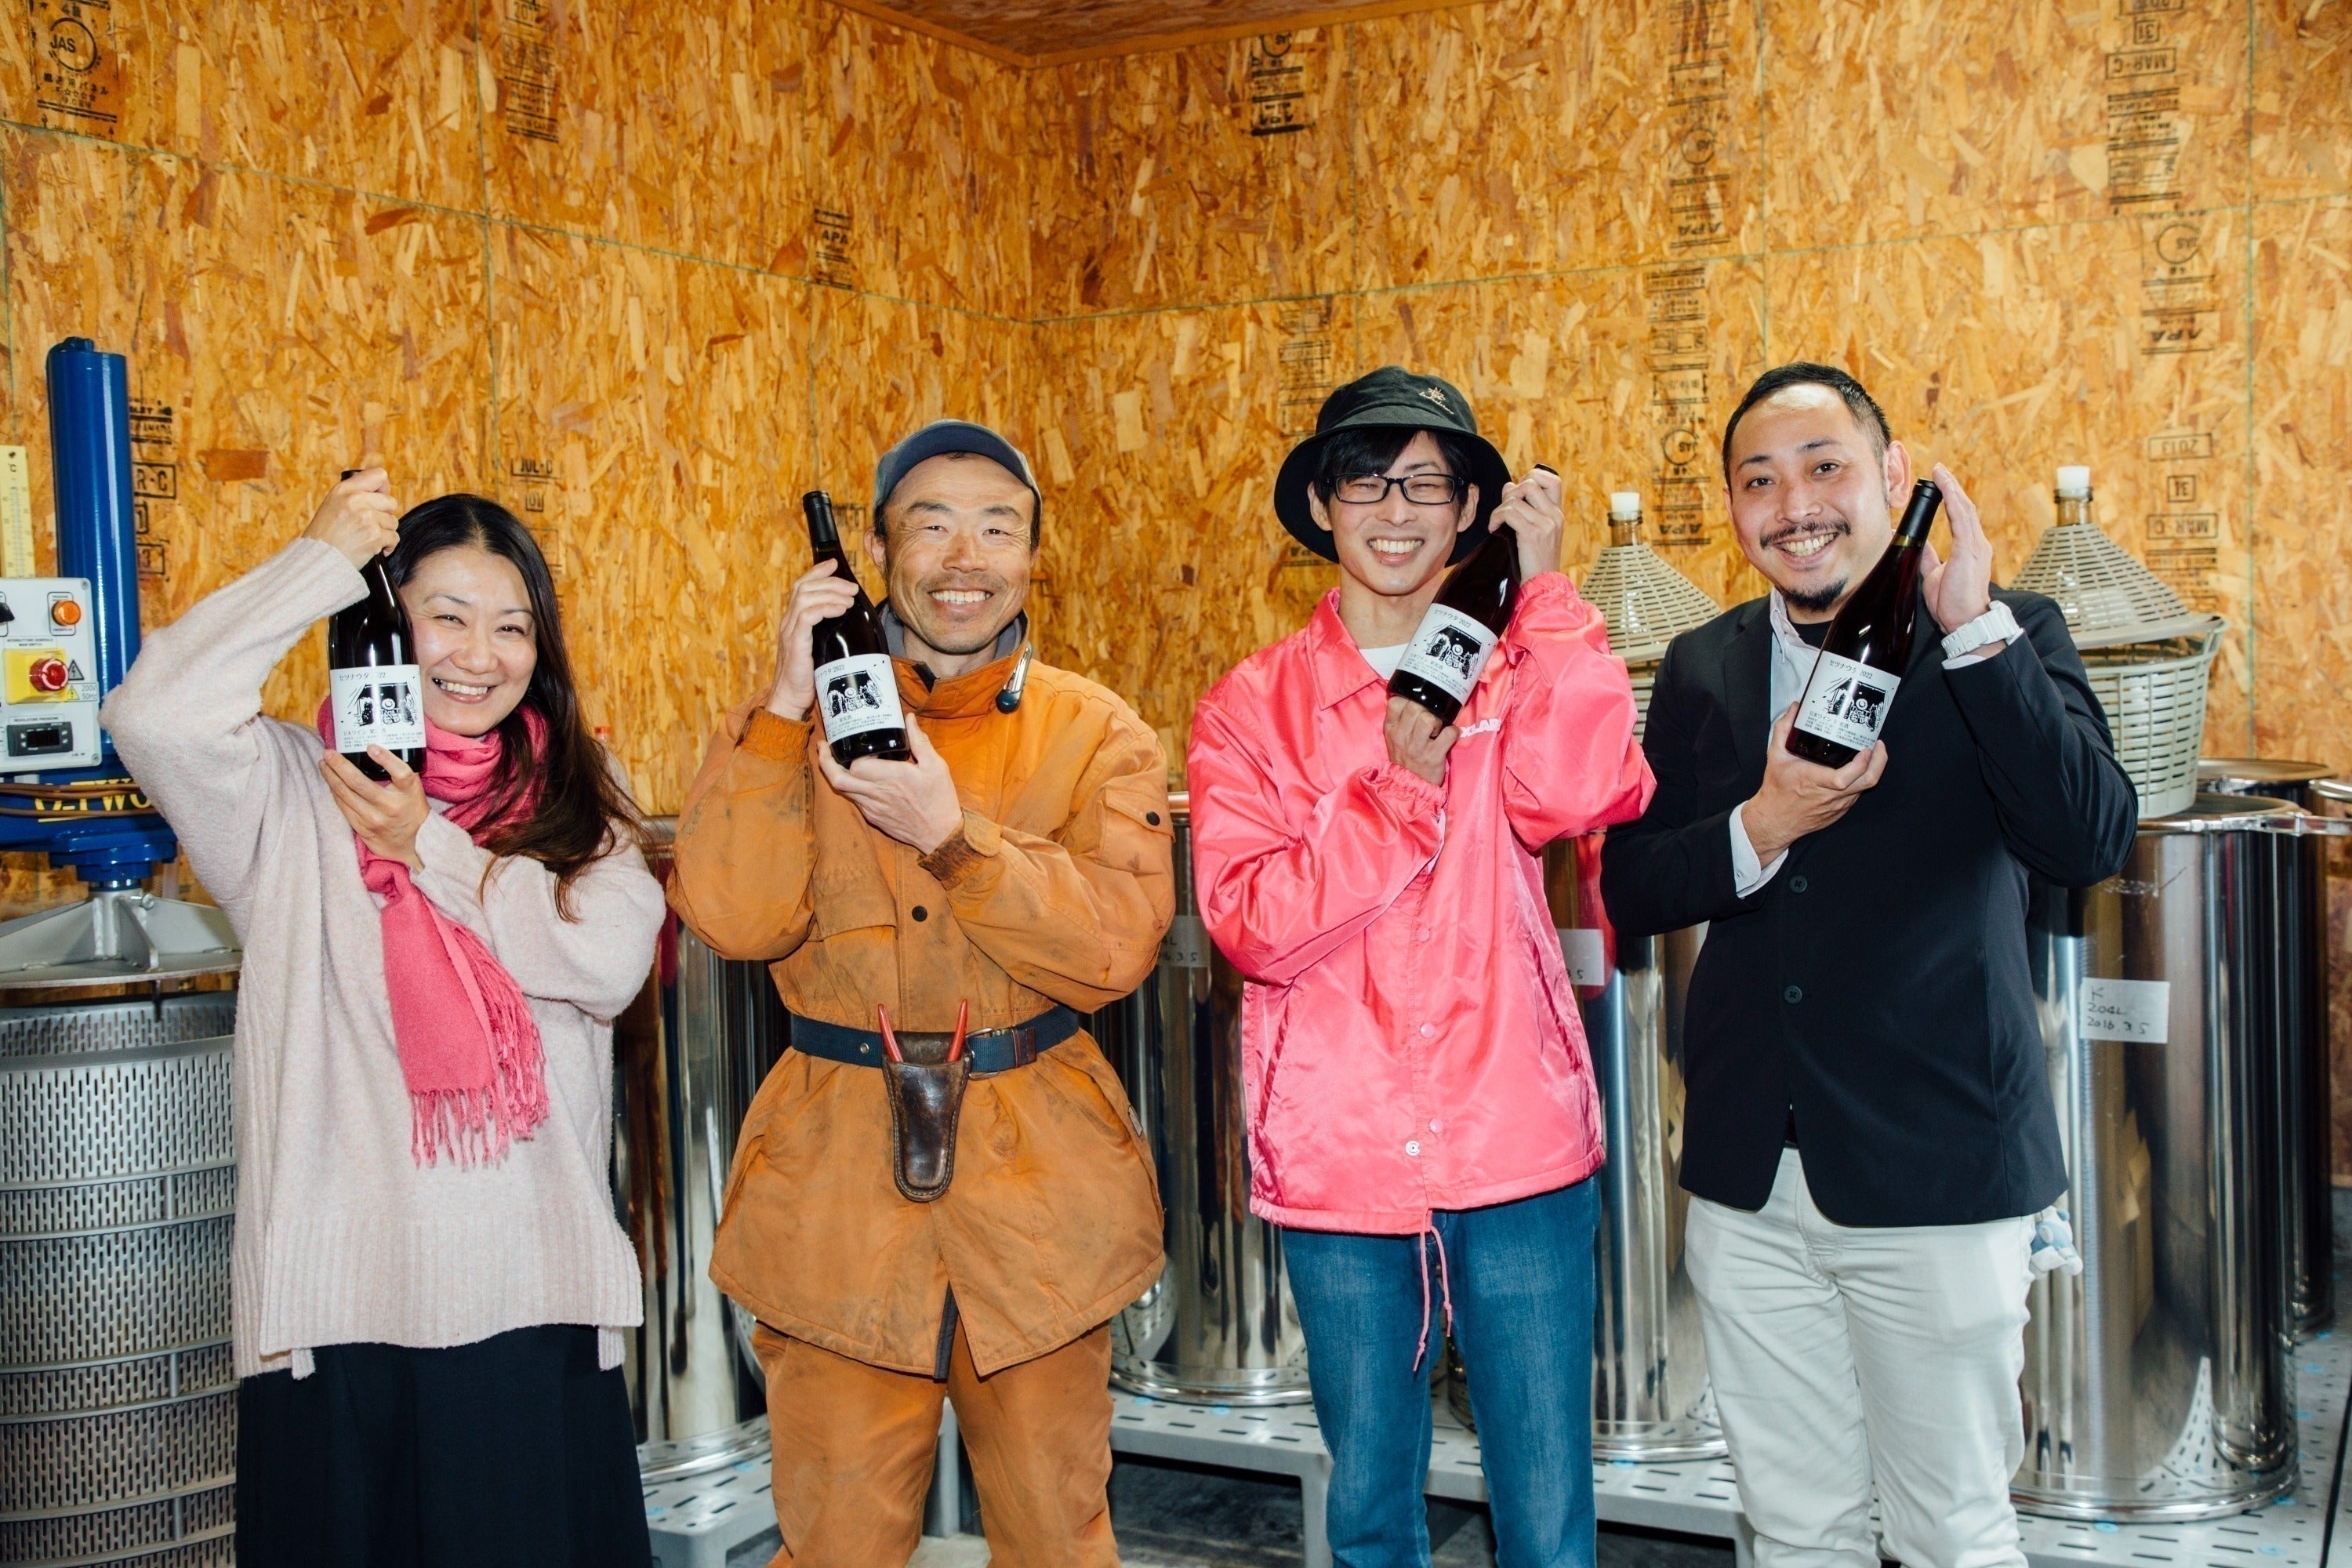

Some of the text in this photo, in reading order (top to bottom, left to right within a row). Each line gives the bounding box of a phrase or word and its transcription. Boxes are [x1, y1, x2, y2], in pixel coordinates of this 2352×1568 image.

[49, 34, 77, 53] JAS
[1676, 221, 1722, 238] APA
[822, 229, 848, 245] APA
[2150, 328, 2203, 342] APA
[1678, 441, 1698, 453] JAS
[2161, 438, 2198, 454] 2013
[1658, 523, 1702, 535] APA
[1458, 617, 1472, 629] 2022
[833, 664, 845, 673] 2022
[1859, 668, 1874, 680] 2022
[338, 672, 369, 681] セツナウタ
[2091, 985, 2104, 1001] K
